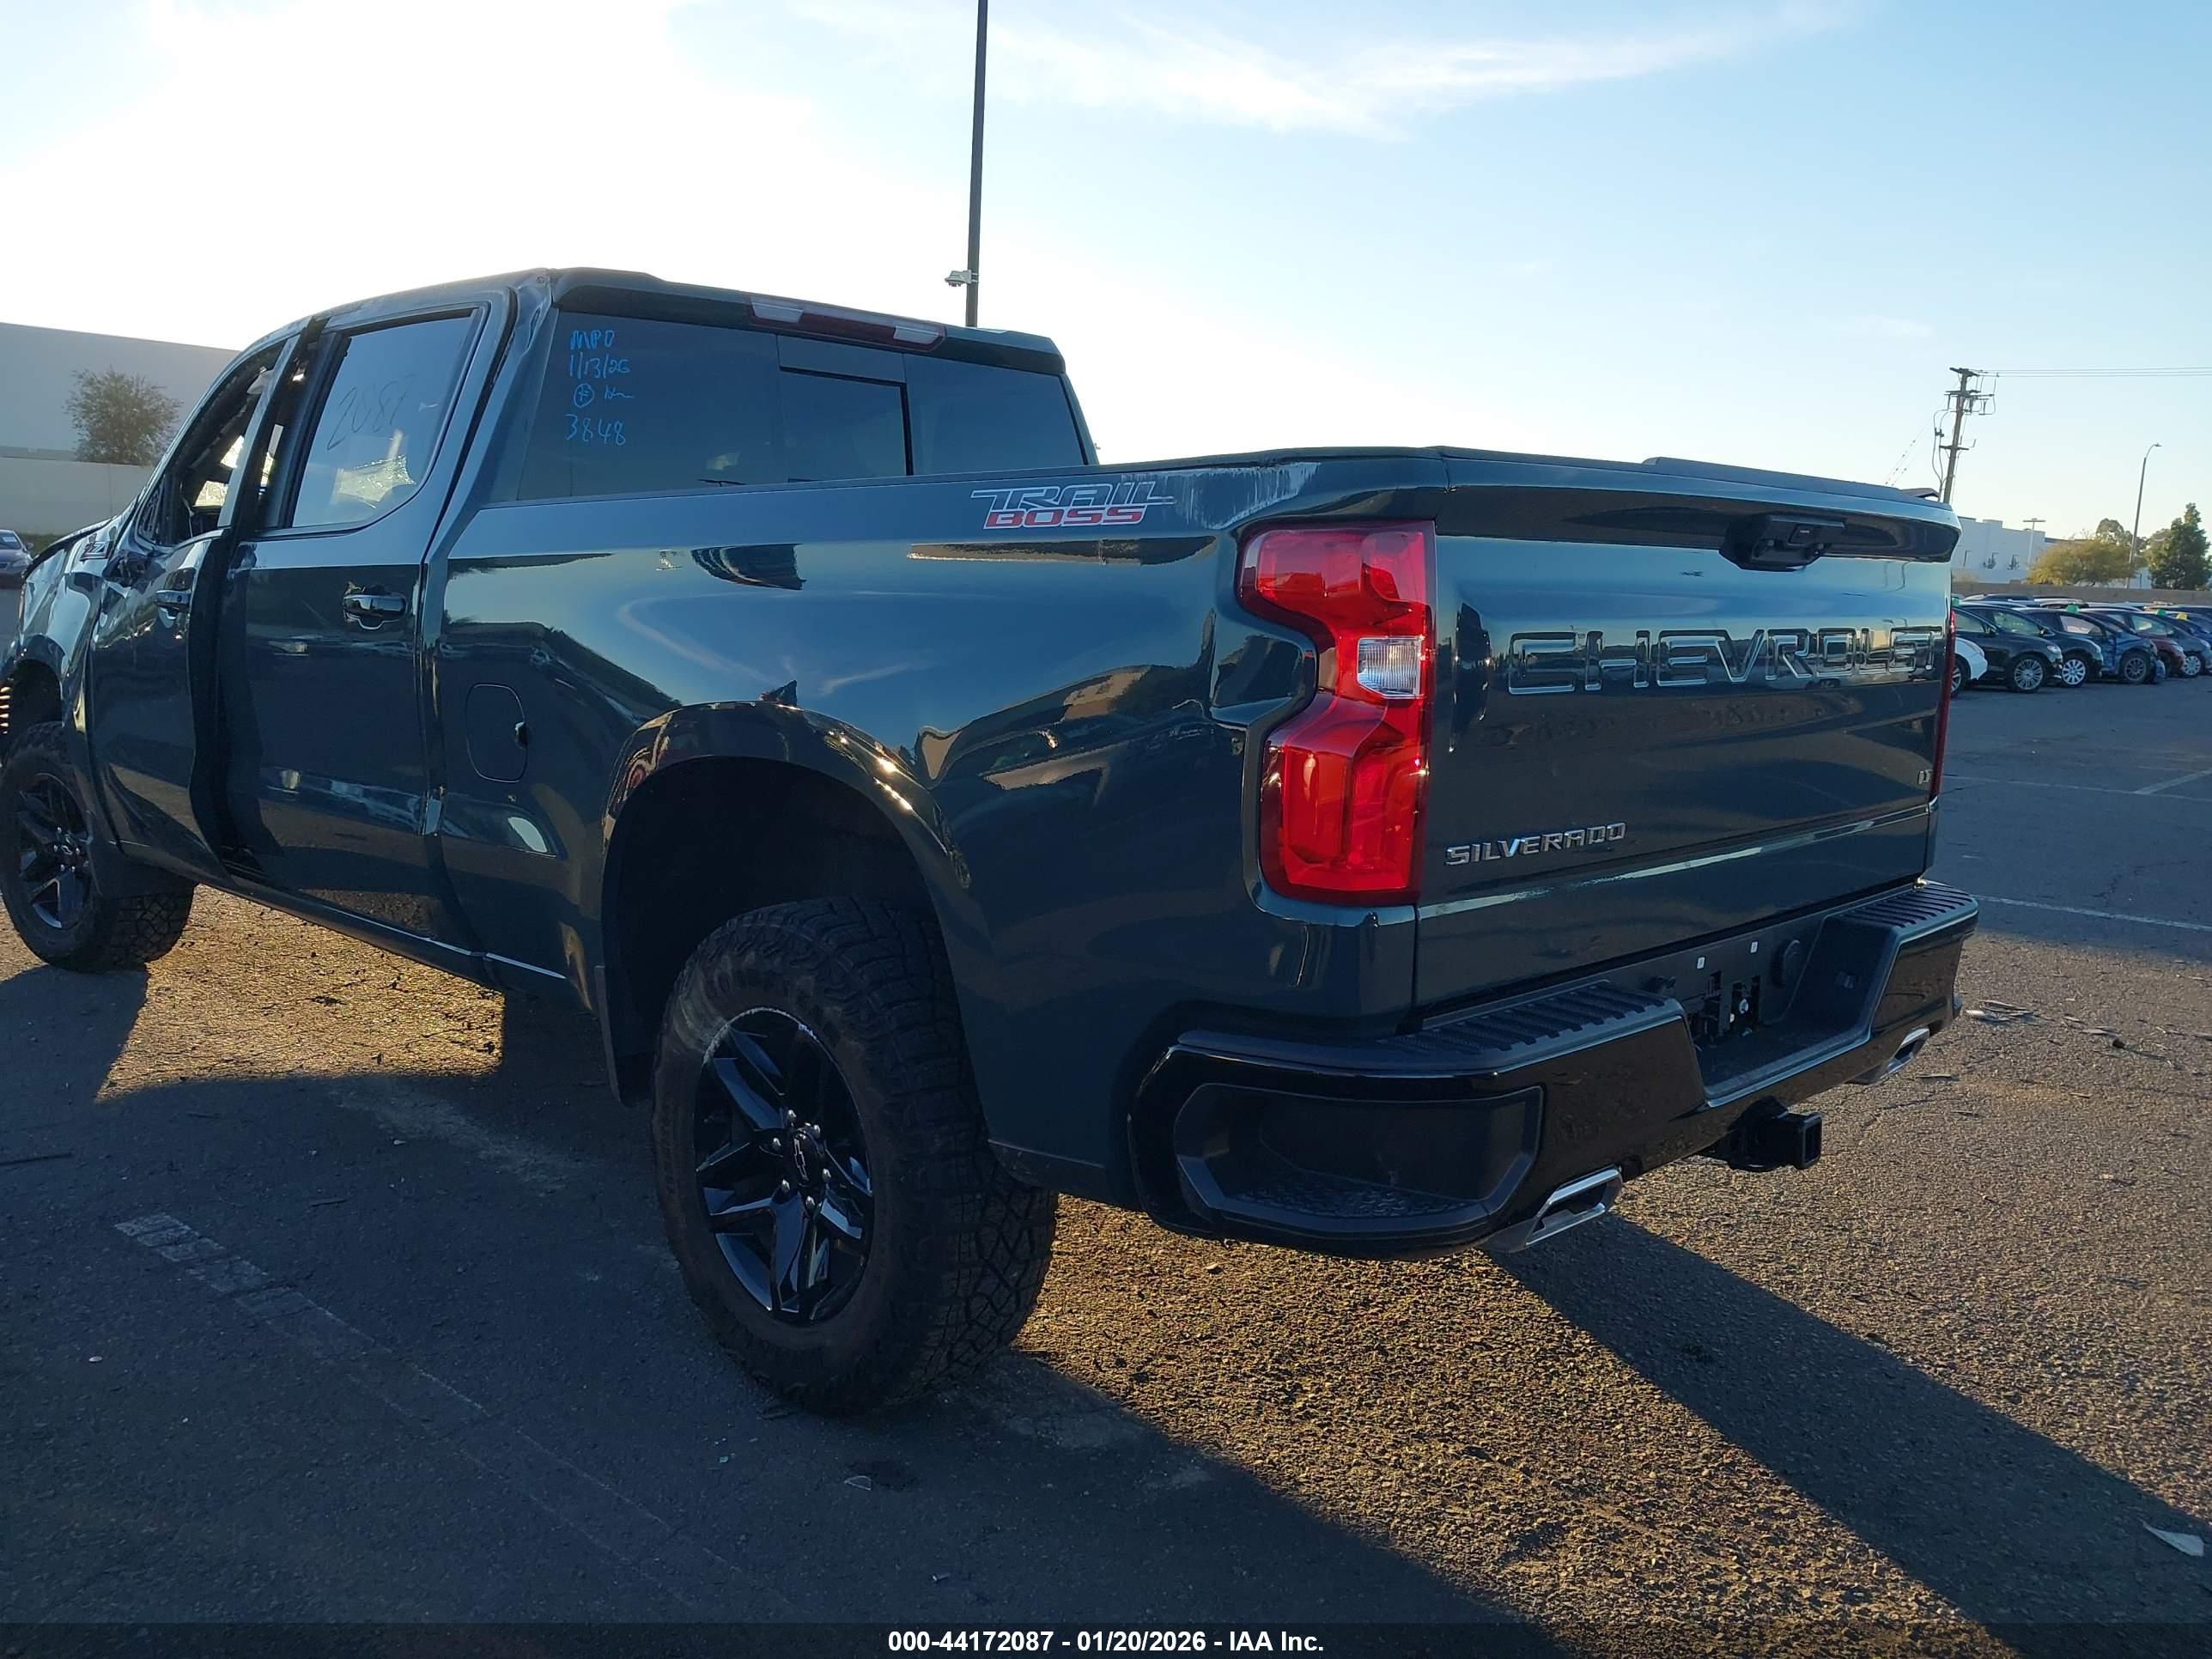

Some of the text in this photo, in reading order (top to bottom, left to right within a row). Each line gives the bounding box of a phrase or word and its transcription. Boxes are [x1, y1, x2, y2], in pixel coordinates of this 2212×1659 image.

[564, 413, 626, 446] 3848
[970, 481, 1176, 512] TRAIL
[983, 504, 1147, 530] BOSS
[1509, 626, 1943, 696] CHEVROLET
[1445, 822, 1626, 866] SILVERADO
